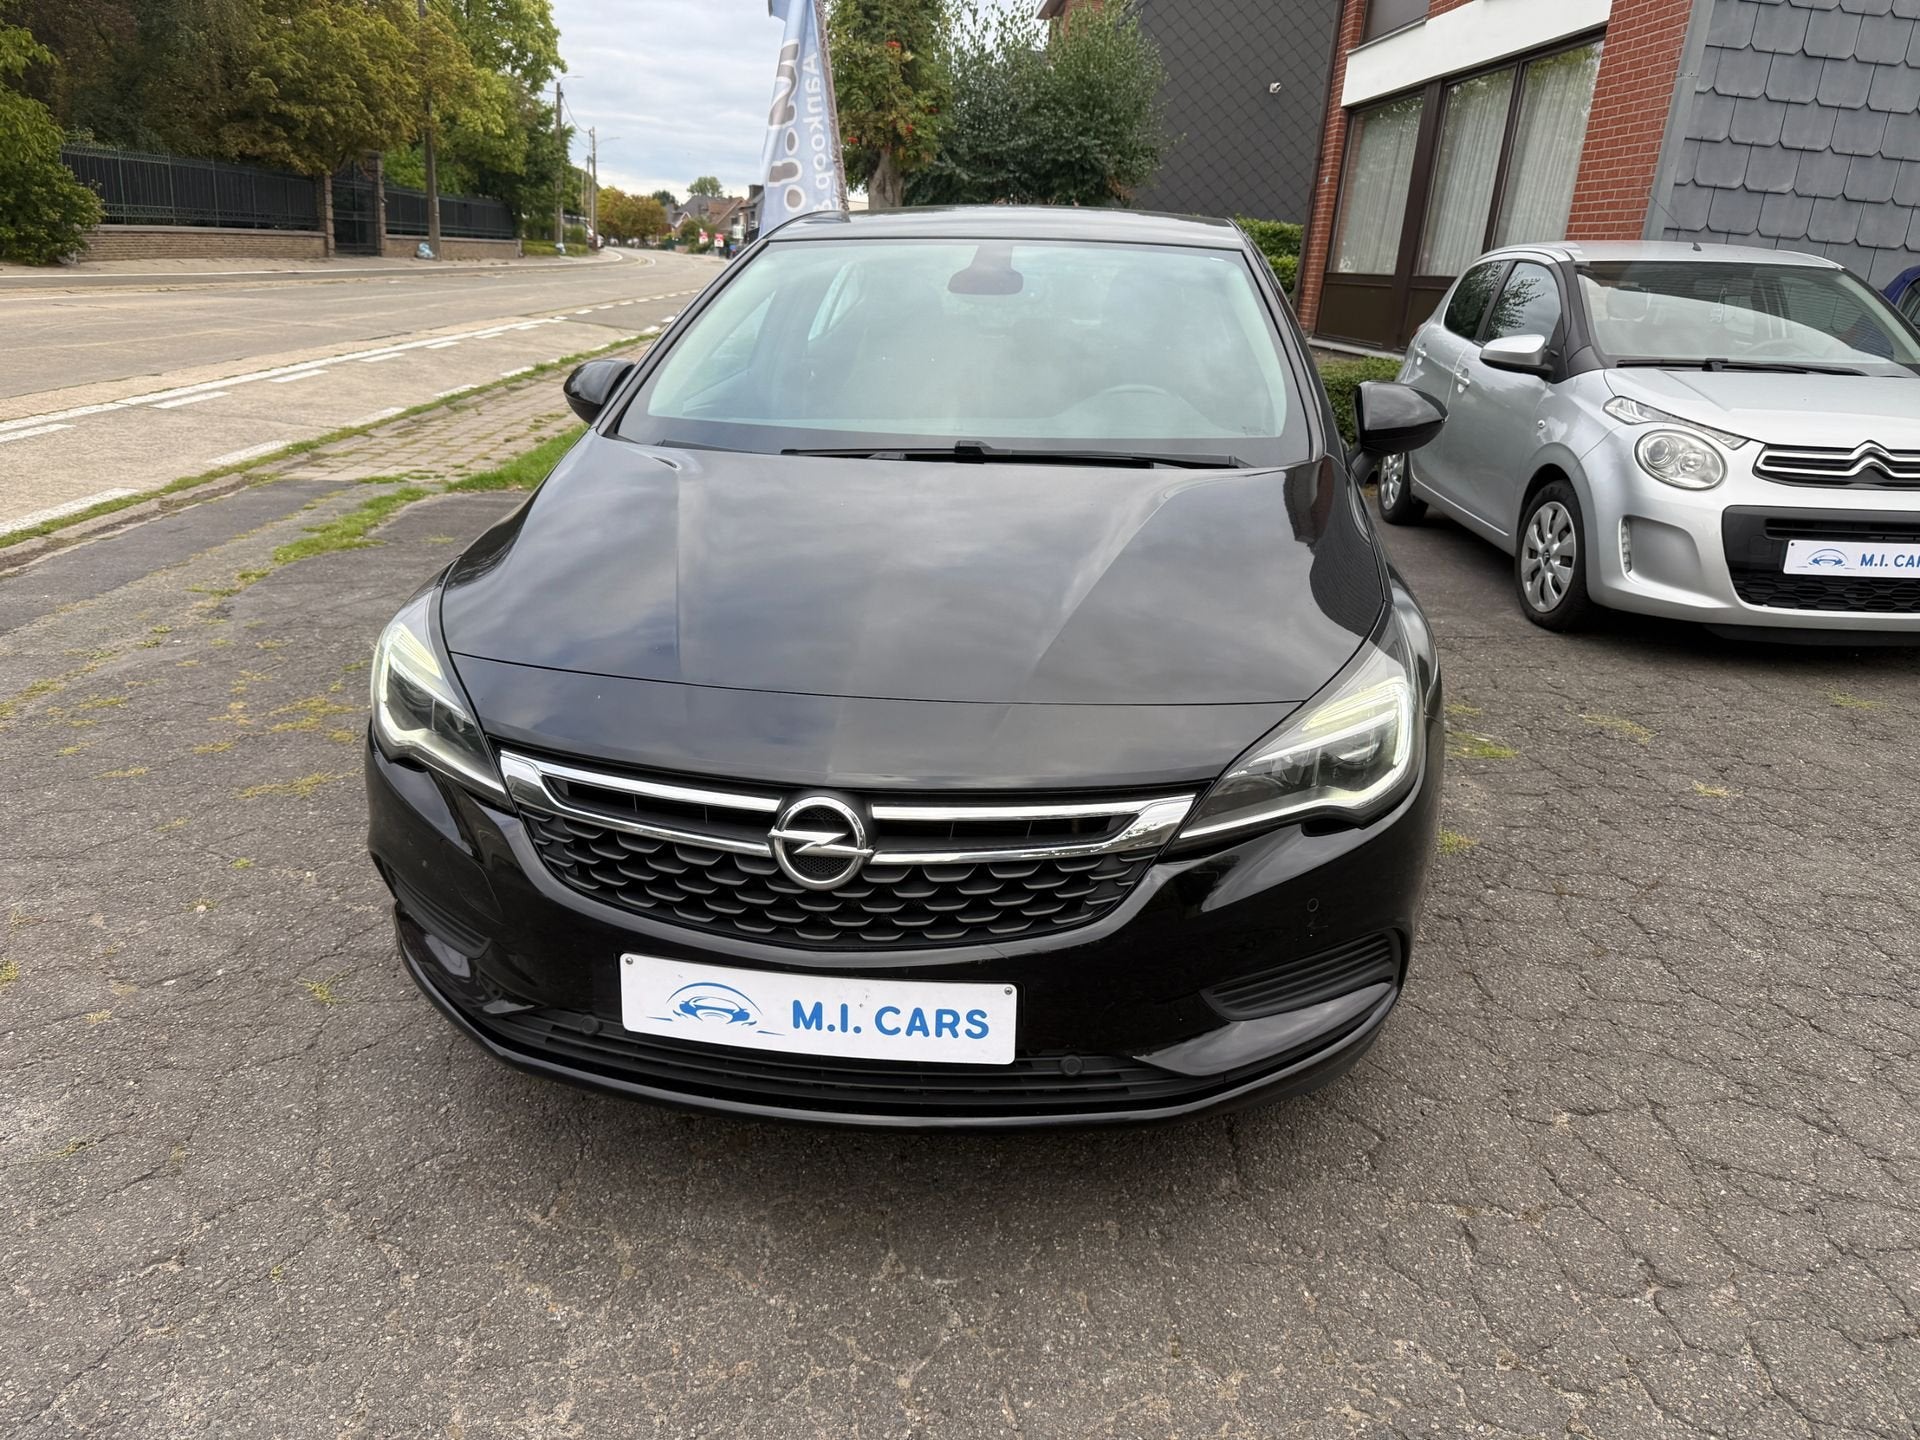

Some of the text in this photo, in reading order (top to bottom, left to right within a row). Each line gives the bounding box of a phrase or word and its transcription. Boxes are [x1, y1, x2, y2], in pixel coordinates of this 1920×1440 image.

[1860, 553, 1888, 567] M.I.
[792, 1000, 989, 1039] M.I. CARS
